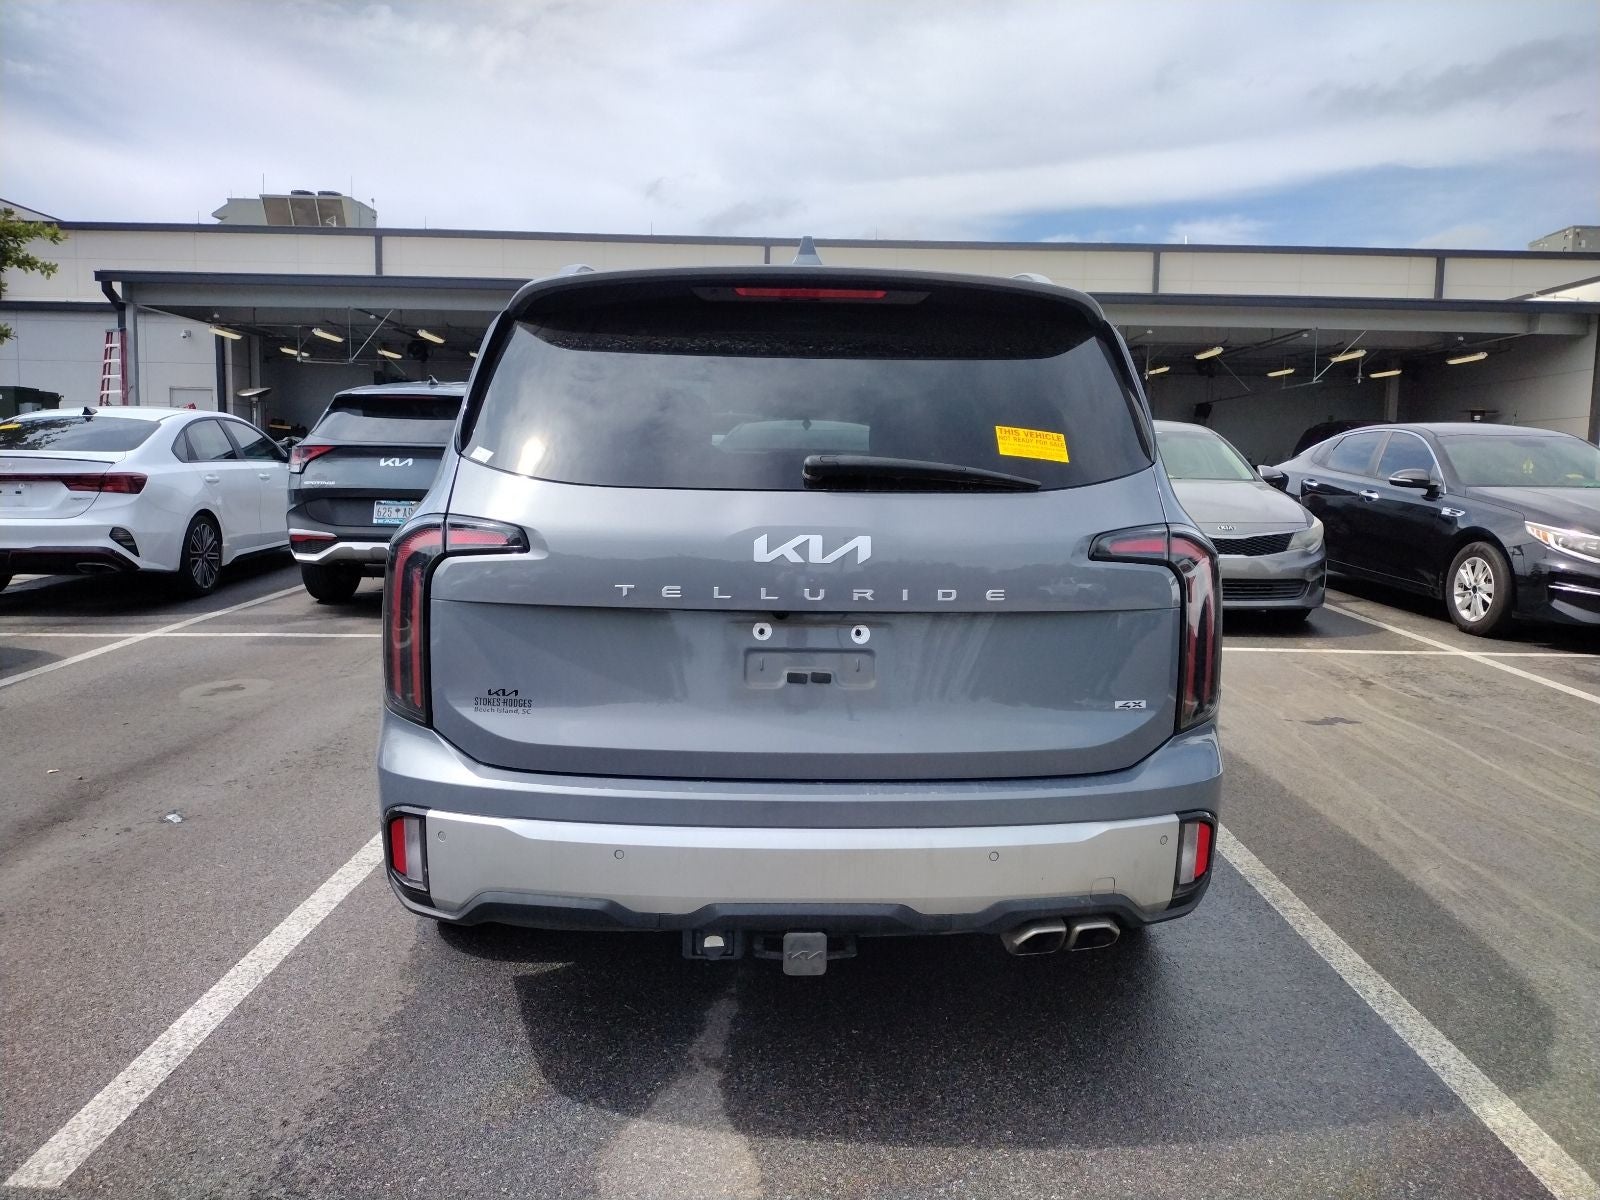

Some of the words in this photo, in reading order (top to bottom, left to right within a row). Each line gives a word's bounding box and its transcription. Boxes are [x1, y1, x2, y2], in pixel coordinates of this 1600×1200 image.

[999, 428, 1021, 437] THIS
[1023, 430, 1062, 442] VEHICLE
[380, 458, 413, 466] KIA
[376, 506, 393, 518] 625
[753, 533, 872, 565] KIA
[614, 584, 1006, 602] TELLURIDE
